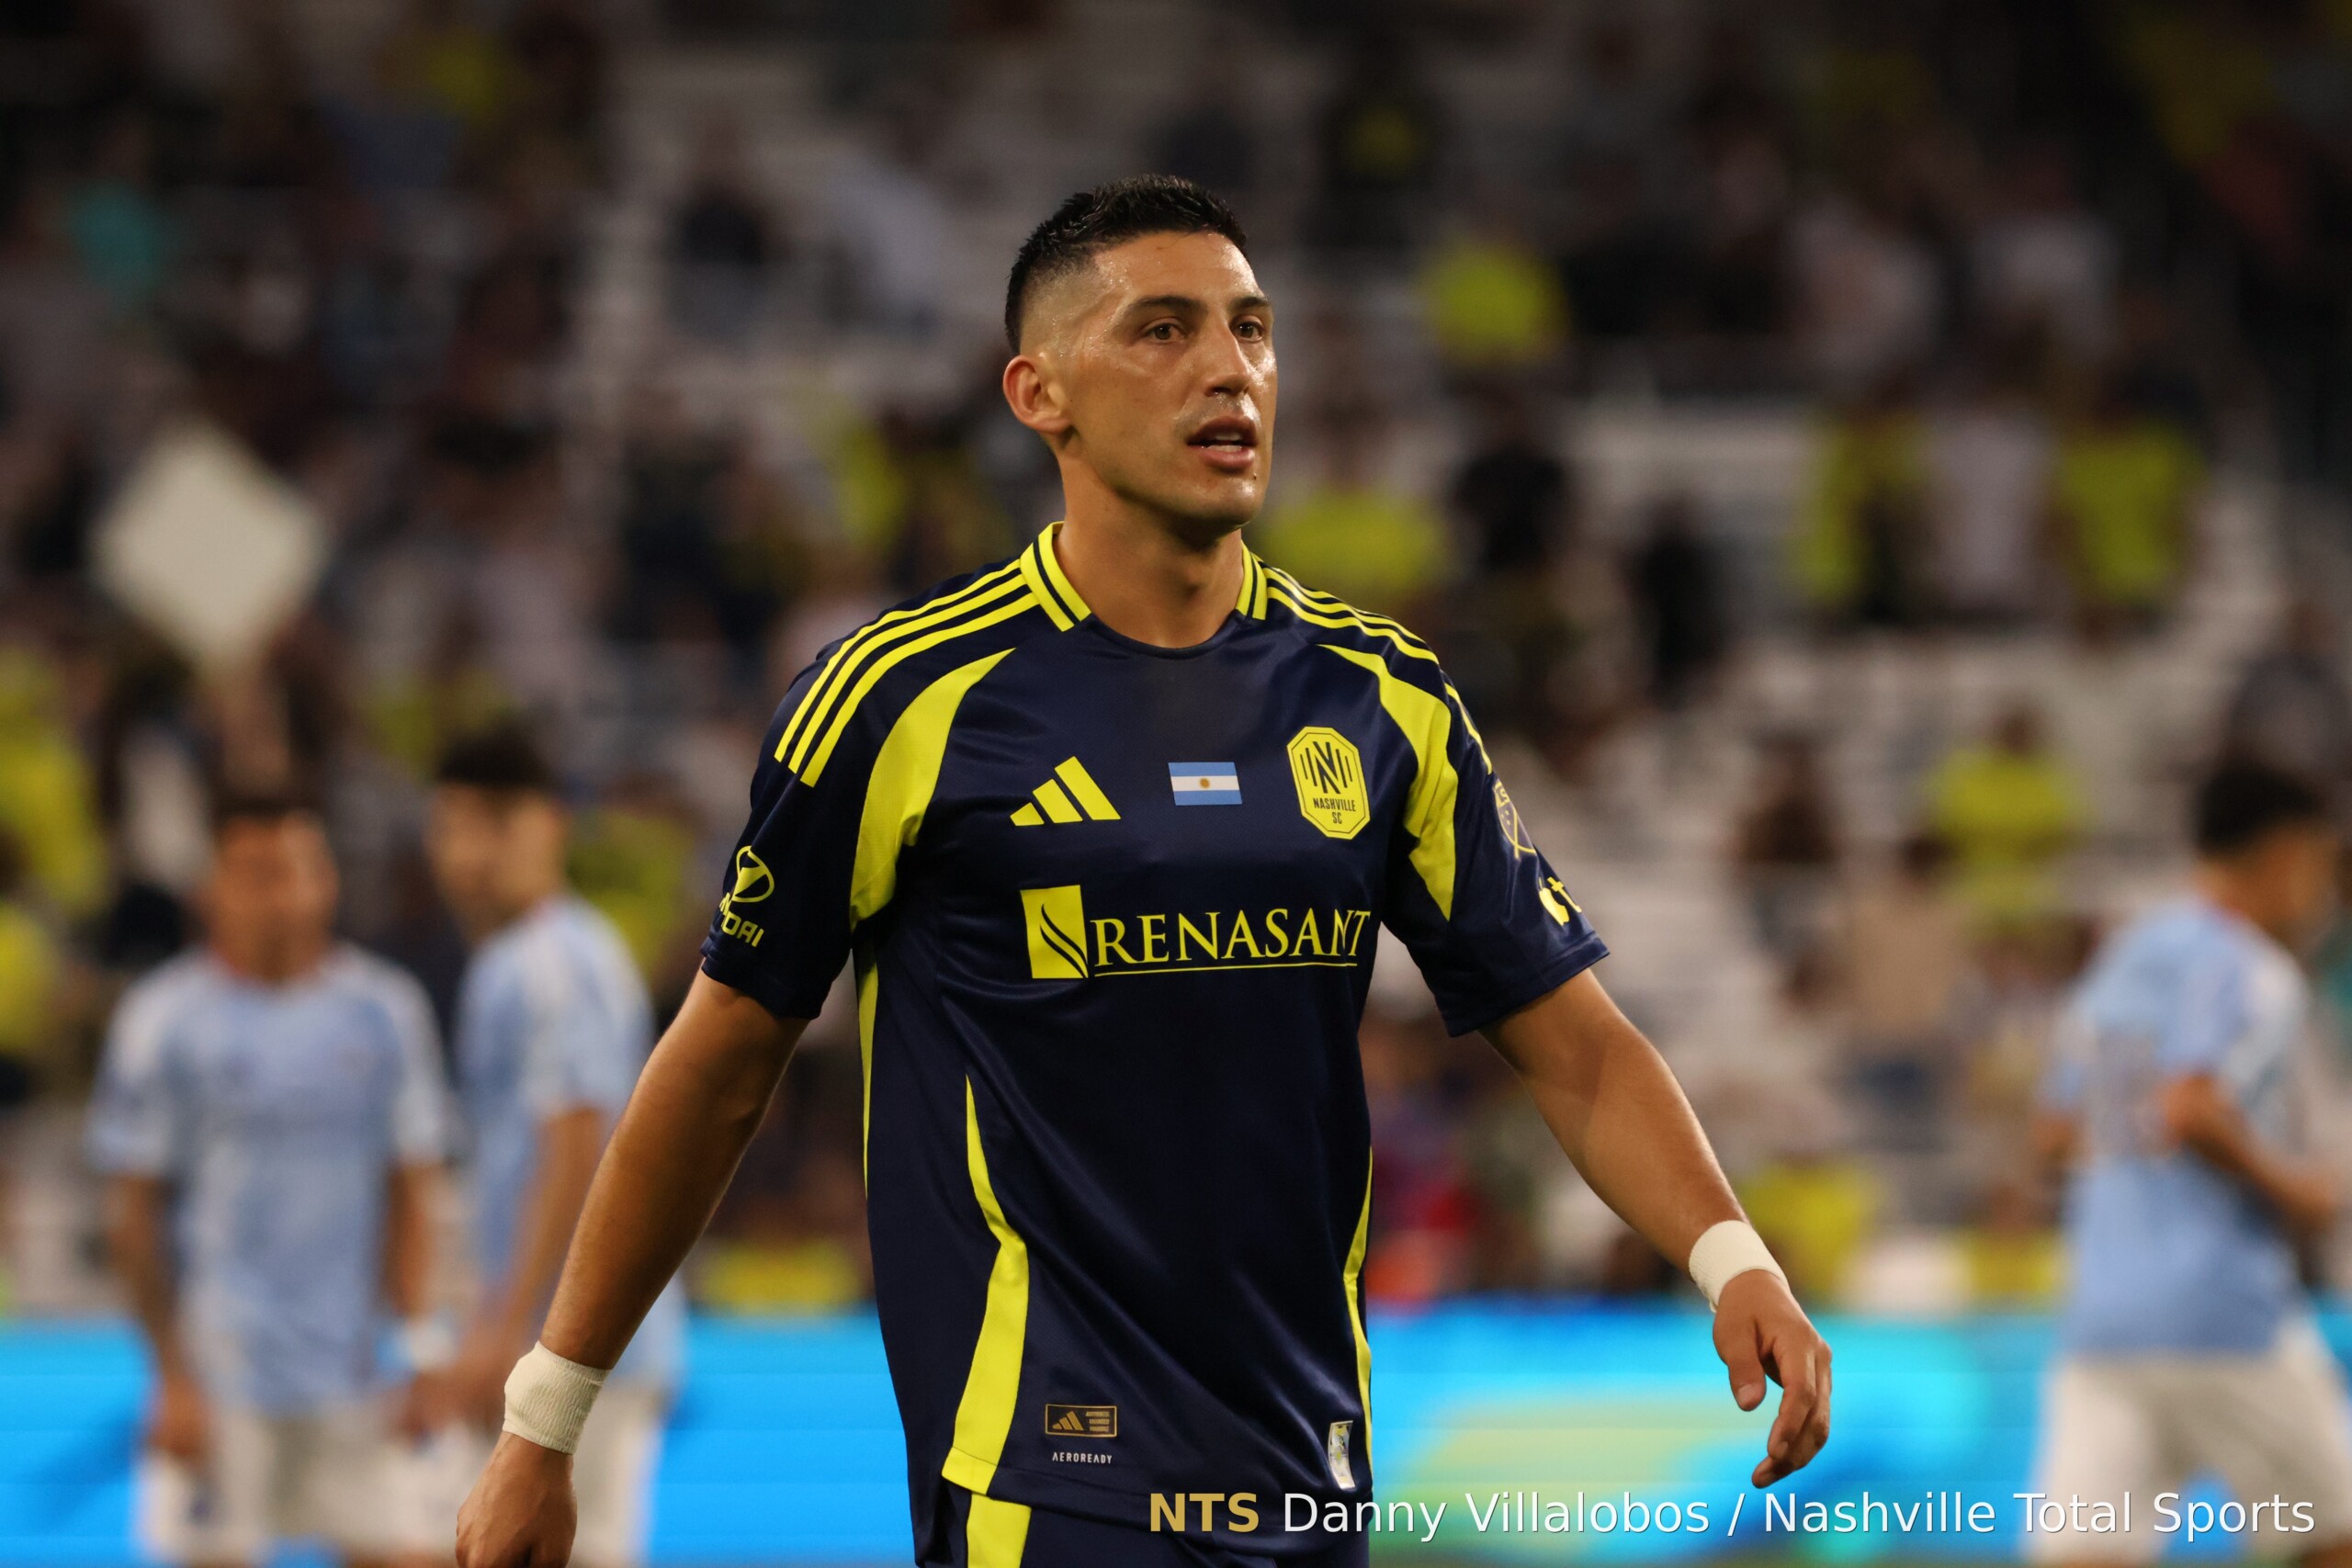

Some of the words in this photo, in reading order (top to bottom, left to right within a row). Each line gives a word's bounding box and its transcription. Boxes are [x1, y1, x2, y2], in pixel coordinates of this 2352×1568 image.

[1312, 797, 1356, 812] NASHVILLE
[1331, 811, 1342, 825] SC
[1090, 908, 1371, 967] RENASANT
[1052, 1451, 1113, 1464] AEROREADY
